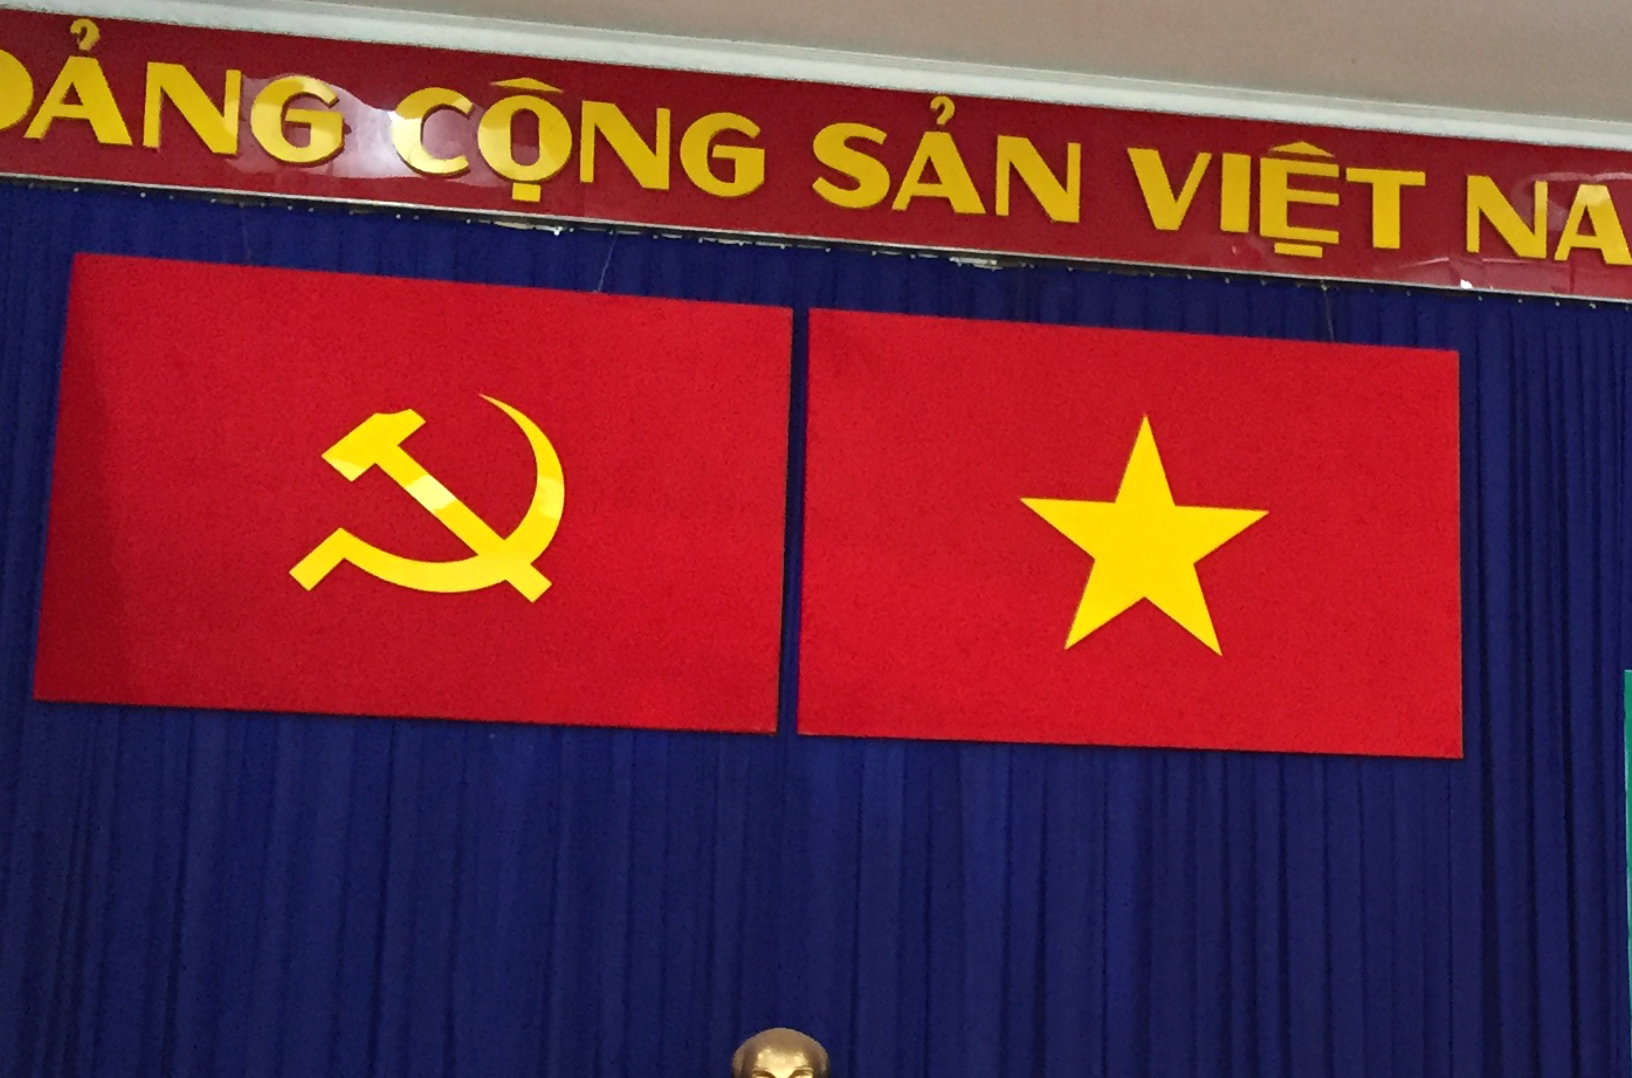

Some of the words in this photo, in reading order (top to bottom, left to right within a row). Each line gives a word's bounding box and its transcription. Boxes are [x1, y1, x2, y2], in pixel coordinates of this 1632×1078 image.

[392, 77, 766, 203] CỘNG
[812, 95, 1082, 224] SẢN
[1127, 141, 1427, 258] VIỆT
